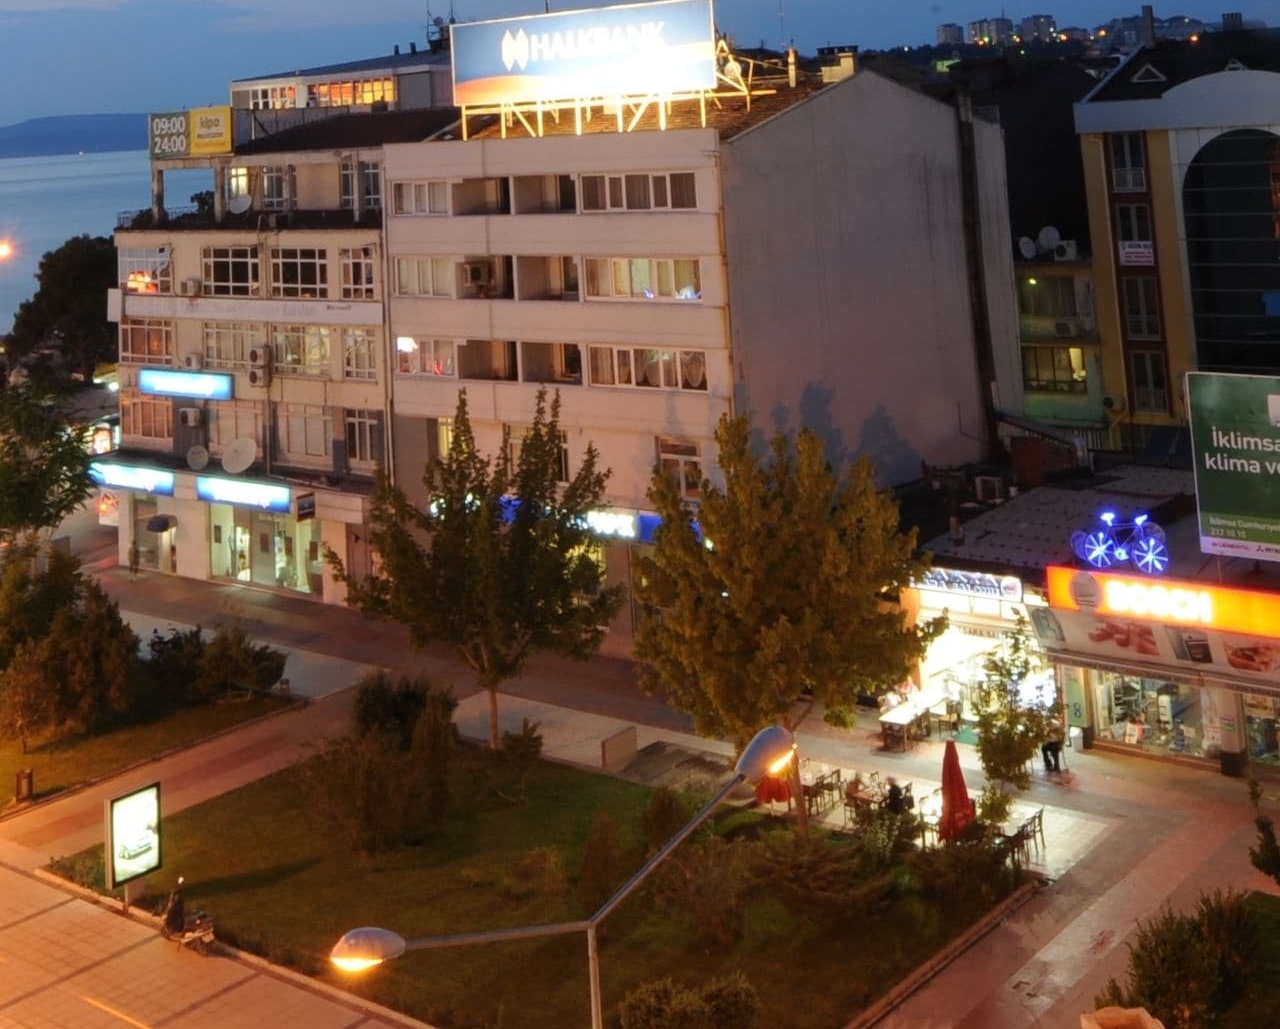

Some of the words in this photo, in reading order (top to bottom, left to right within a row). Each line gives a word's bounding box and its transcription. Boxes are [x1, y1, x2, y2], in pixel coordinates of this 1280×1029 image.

[530, 21, 665, 61] HALKBANK
[153, 116, 186, 135] 09:00
[154, 135, 186, 153] 24:00
[1205, 452, 1261, 474] klima
[1107, 581, 1212, 622] BOSCH
